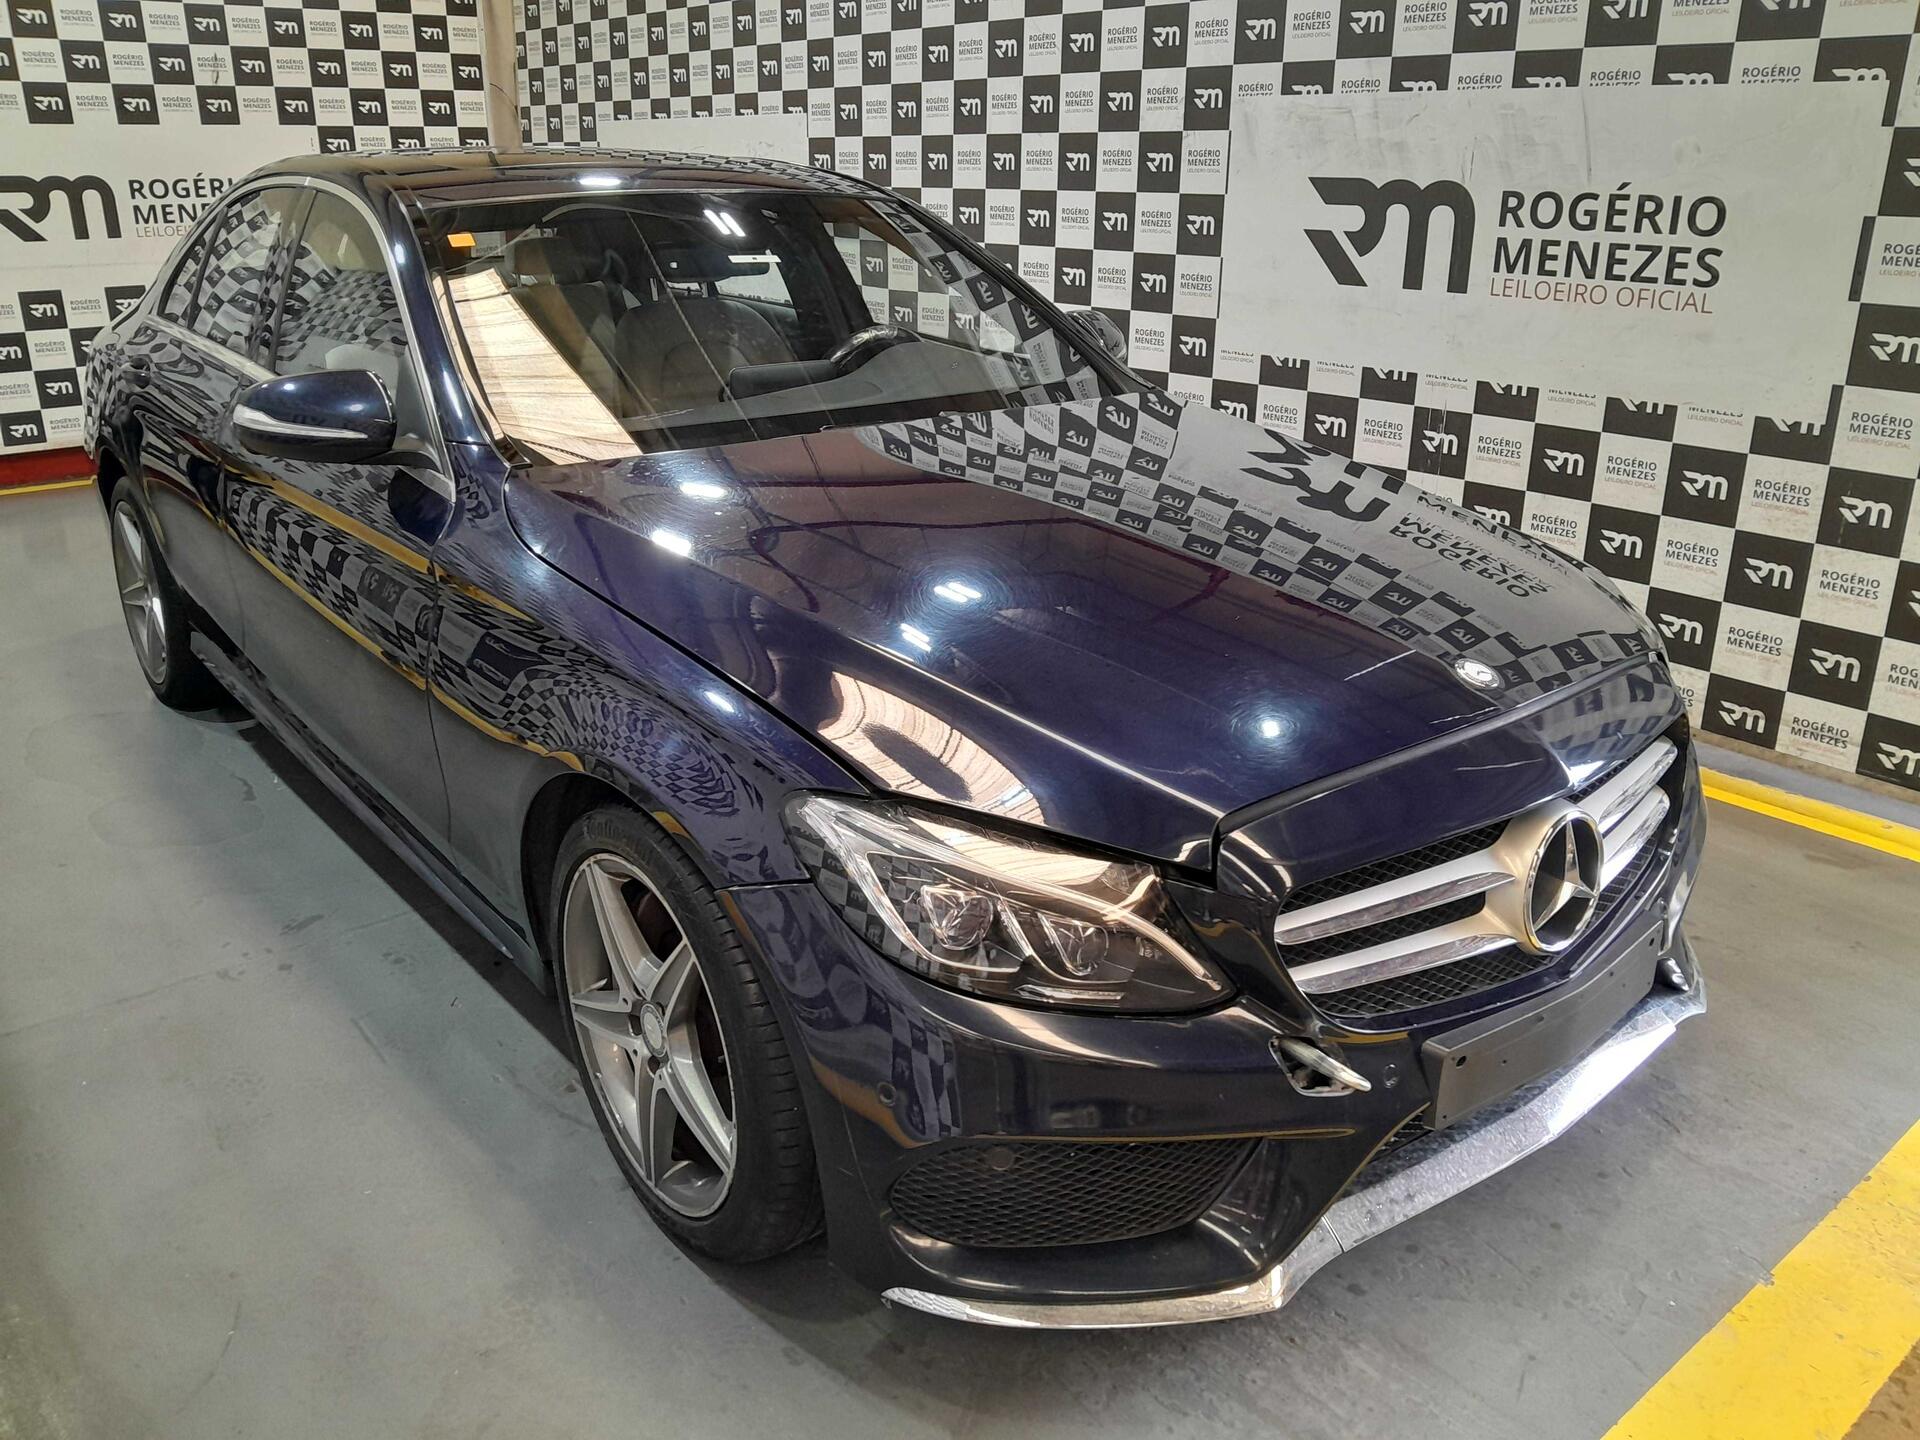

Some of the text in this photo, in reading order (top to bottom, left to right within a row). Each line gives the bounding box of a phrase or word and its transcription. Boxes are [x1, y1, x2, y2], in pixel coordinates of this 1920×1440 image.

[1405, 1, 1447, 13] ROGÉRIO
[1529, 3, 1578, 16] MENEZES
[1294, 10, 1331, 21] ROGÉRIO
[1404, 12, 1446, 24] MENEZES
[1195, 18, 1228, 29] ROGÉRIO
[1293, 20, 1330, 31] MENEZES
[1195, 28, 1228, 38] MENEZES
[1591, 68, 1641, 80] ROGÉRIO
[1742, 64, 1800, 79] ROGÉRIO
[1342, 78, 1380, 88] ROGÉRIO
[1458, 73, 1502, 84] ROGÉRIO
[1147, 86, 1178, 95] ROGÉRIO
[1239, 82, 1273, 92] ROGÉRIO
[1147, 96, 1178, 104] MENEZES
[1188, 148, 1220, 157] ROGÉRIO
[1188, 158, 1220, 166] MENEZES
[1499, 182, 1727, 237] ROGÉRIO
[1493, 237, 1723, 288] MENEZES
[1181, 273, 1212, 282] ROGÉRIO
[1180, 282, 1212, 291] MENEZES
[1490, 278, 1713, 314] LEILOEIRO OFICIAL
[1264, 404, 1298, 416] ROGÉRIO
[1263, 412, 1297, 424] MENEZES
[1852, 412, 1913, 428] ROGÉRIO
[1365, 419, 1403, 431] ROGÉRIO
[1364, 428, 1402, 441] MENEZES
[1850, 423, 1911, 441] MENEZES
[1478, 436, 1522, 449] ROGÉRIO
[1477, 445, 1520, 459] MENEZES
[1608, 456, 1656, 471] ROGÉRIO
[1605, 466, 1656, 481] MENEZES
[1755, 479, 1811, 496] ROGÉRIO
[1752, 490, 1809, 507] MENEZES
[1531, 513, 1578, 530] ROGÉRIO
[1530, 522, 1577, 539] MENEZES
[1667, 540, 1718, 556] ROGÉRIO
[1666, 550, 1718, 568] MENEZES
[1822, 570, 1880, 588] ROGÉRIO
[1820, 580, 1878, 600] MENEZES
[1729, 627, 1782, 646] ROGÉRIO
[1727, 636, 1781, 656] MENEZES
[1792, 716, 1849, 738] ROGÉRIO
[1790, 727, 1848, 750] MENEZES
